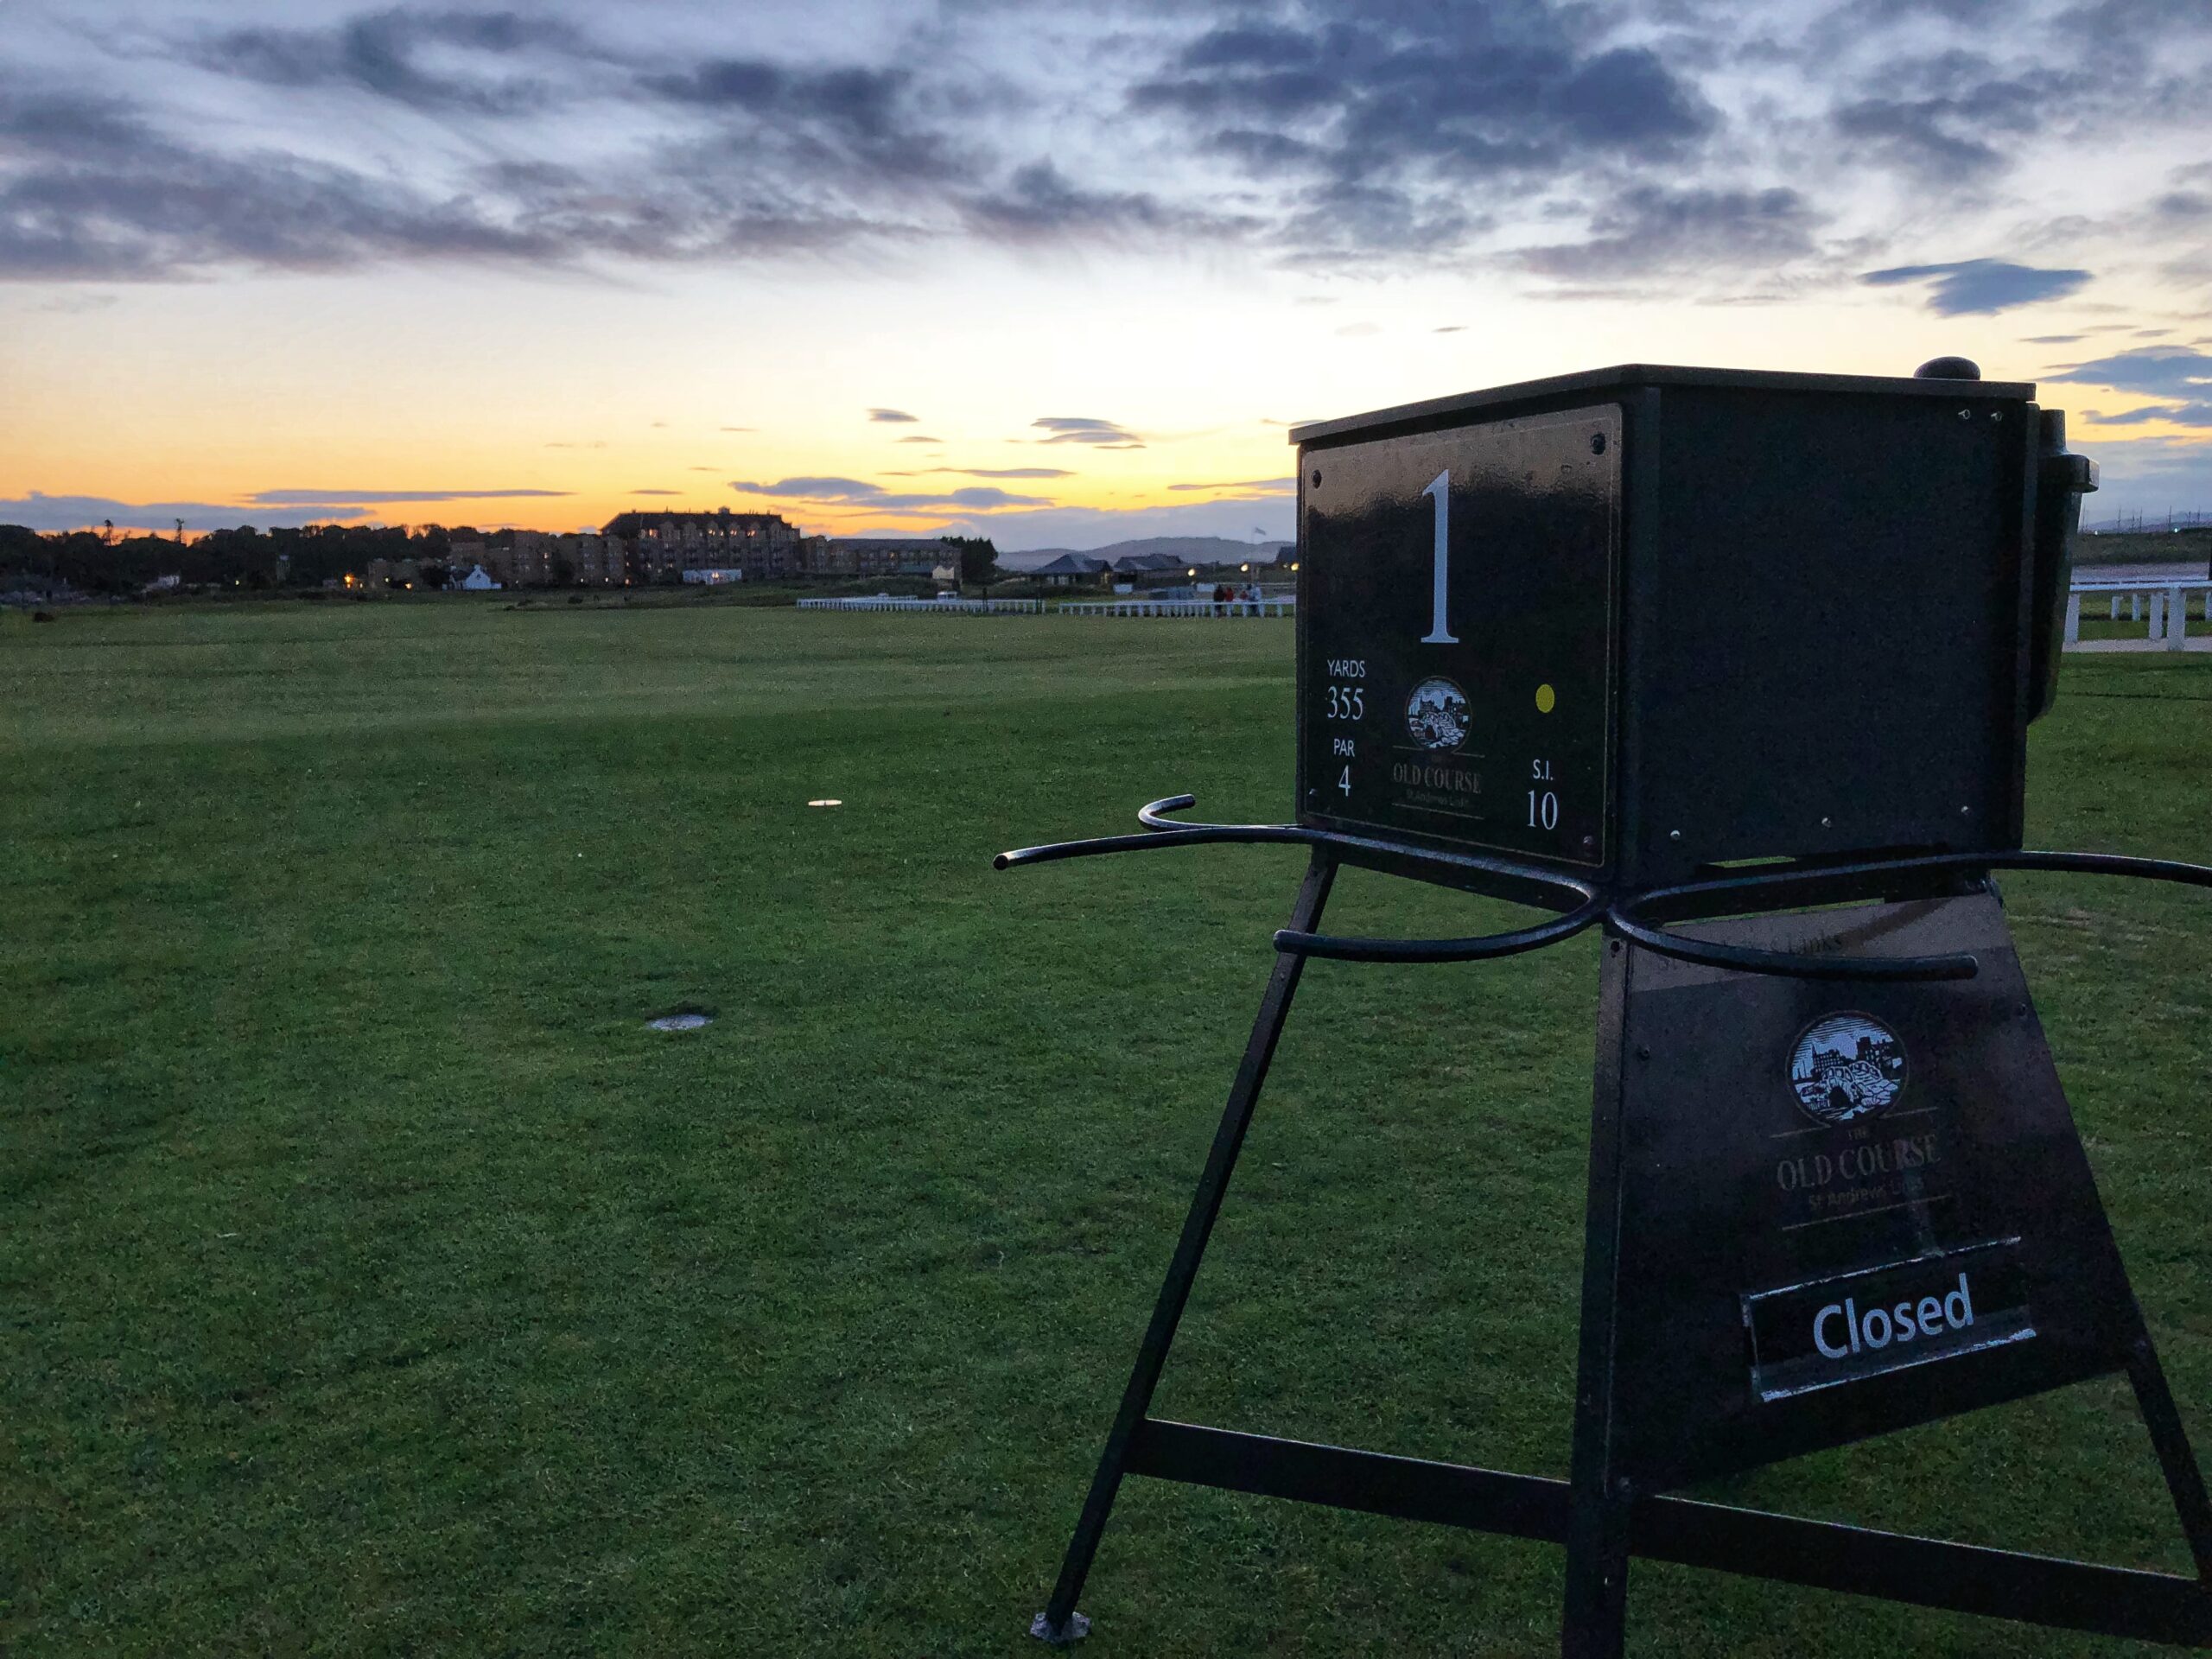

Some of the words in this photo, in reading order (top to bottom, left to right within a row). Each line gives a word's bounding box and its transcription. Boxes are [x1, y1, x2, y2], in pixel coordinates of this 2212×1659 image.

[1421, 469, 1459, 644] 1
[1327, 659, 1365, 678] YARDS
[1327, 685, 1364, 721] 355
[1333, 738, 1356, 758] PAR
[1338, 765, 1351, 797] 4
[1393, 762, 1421, 785] OLD
[1423, 766, 1482, 794] COURSE
[1532, 759, 1554, 781] S.I.
[1527, 790, 1558, 830] 10
[1777, 1154, 1832, 1191] OLD
[1839, 1133, 1942, 1180] COURSE
[1813, 1271, 1974, 1358] Closed
